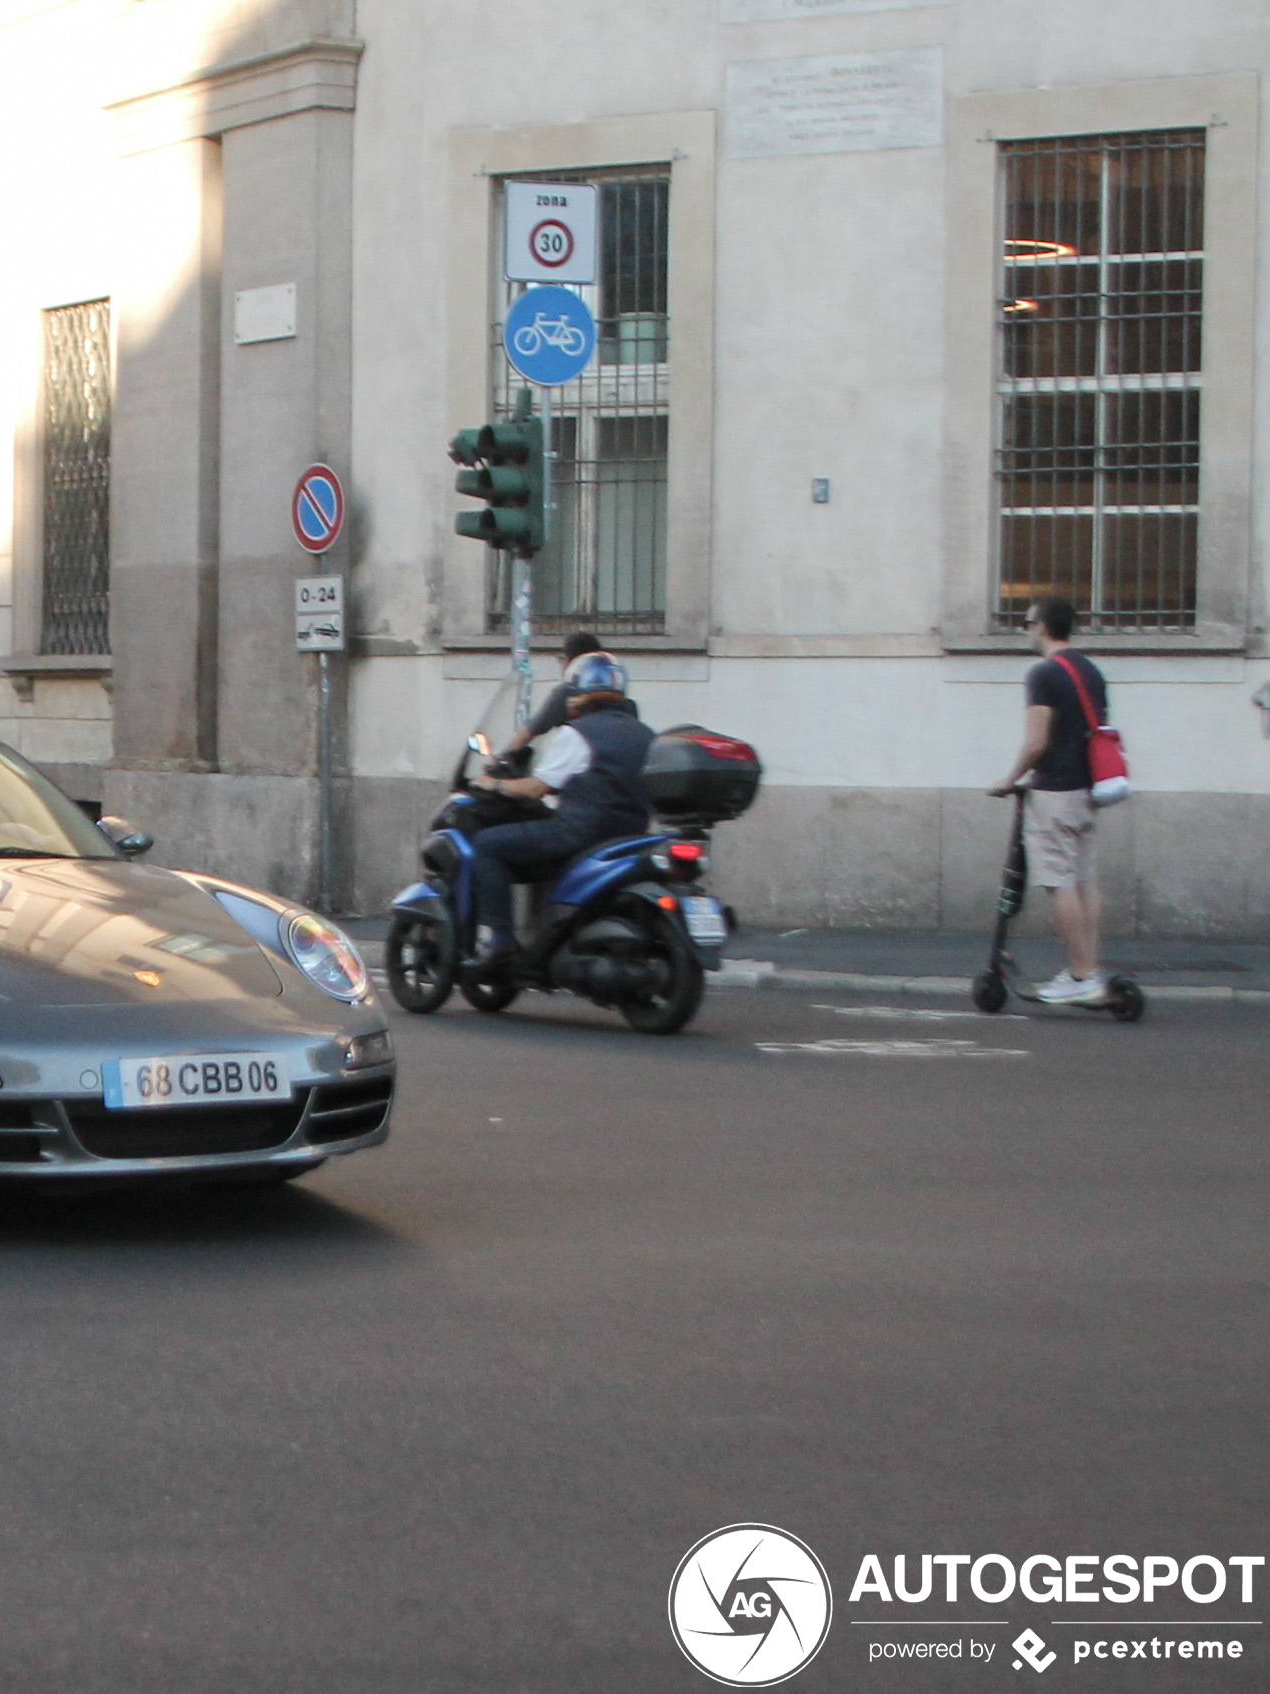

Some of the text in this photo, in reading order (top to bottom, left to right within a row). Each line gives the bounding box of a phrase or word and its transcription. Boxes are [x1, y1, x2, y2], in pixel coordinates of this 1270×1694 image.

[536, 194, 567, 207] zona
[540, 233, 563, 253] 30
[136, 1061, 278, 1097] 68 CBB 06
